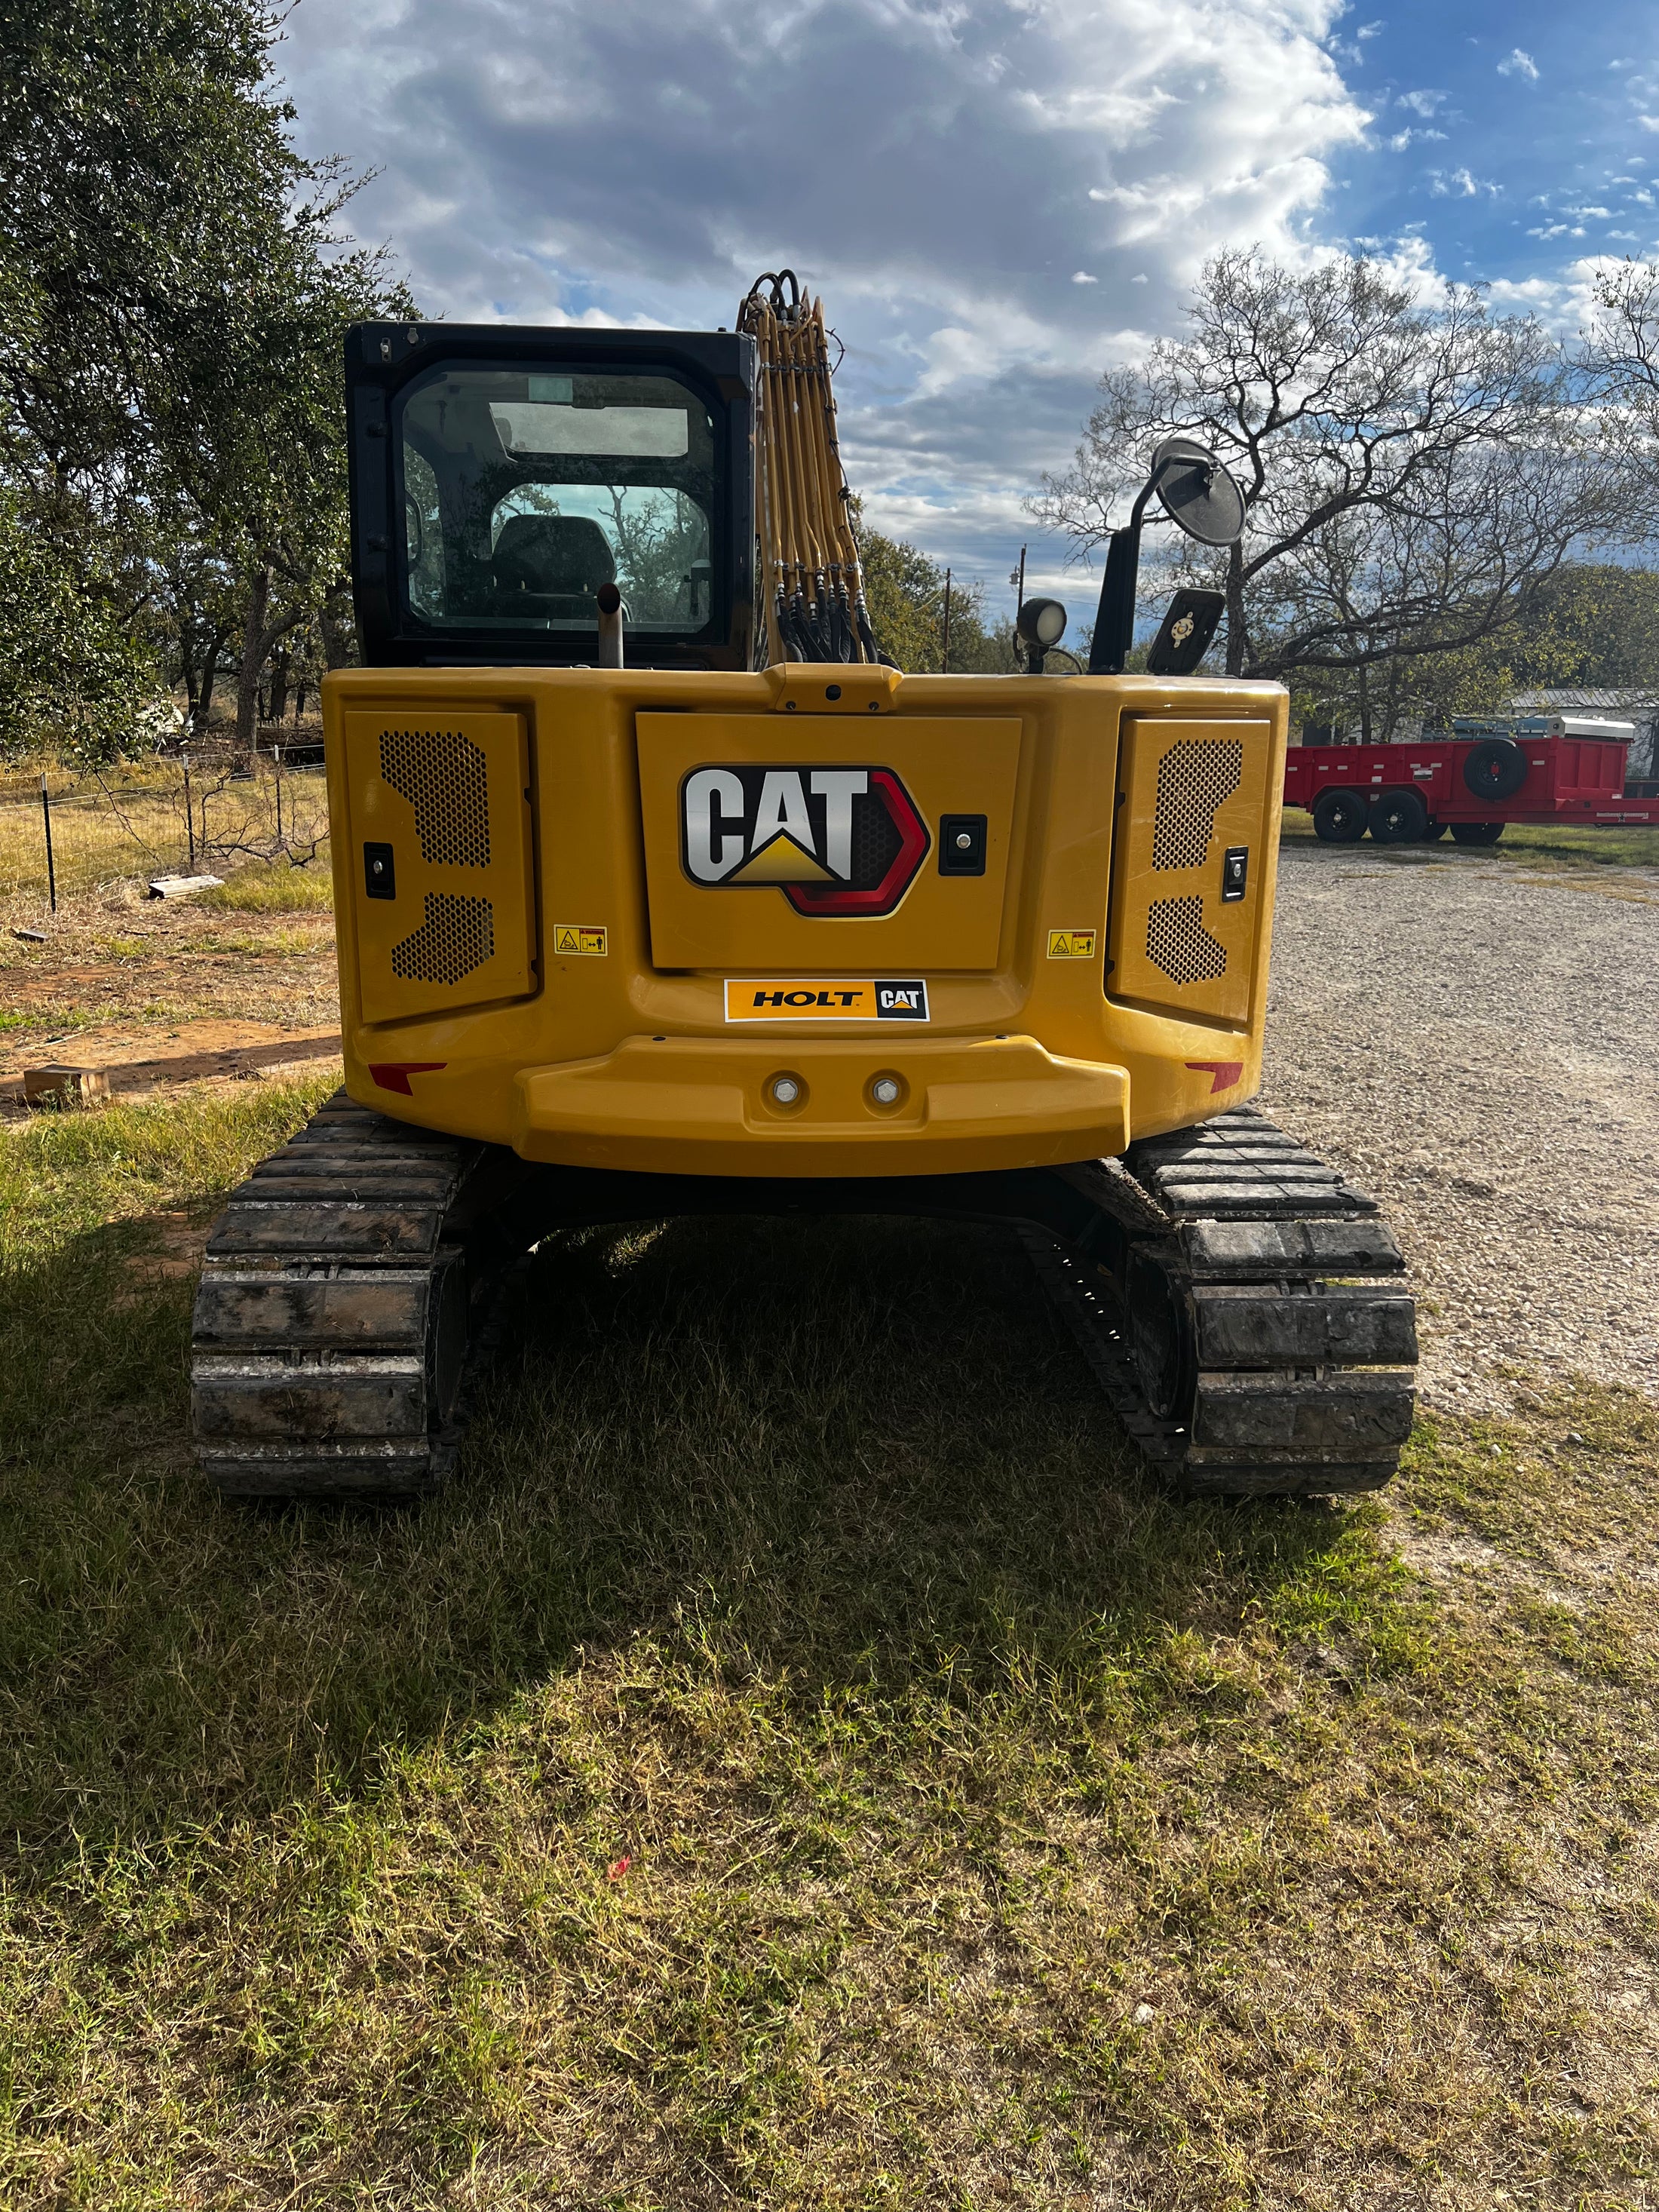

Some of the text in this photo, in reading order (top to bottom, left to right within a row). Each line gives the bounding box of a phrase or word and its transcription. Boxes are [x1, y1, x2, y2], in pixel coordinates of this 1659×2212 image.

[686, 769, 867, 882] CAT
[753, 990, 918, 1009] HOLT CAT
